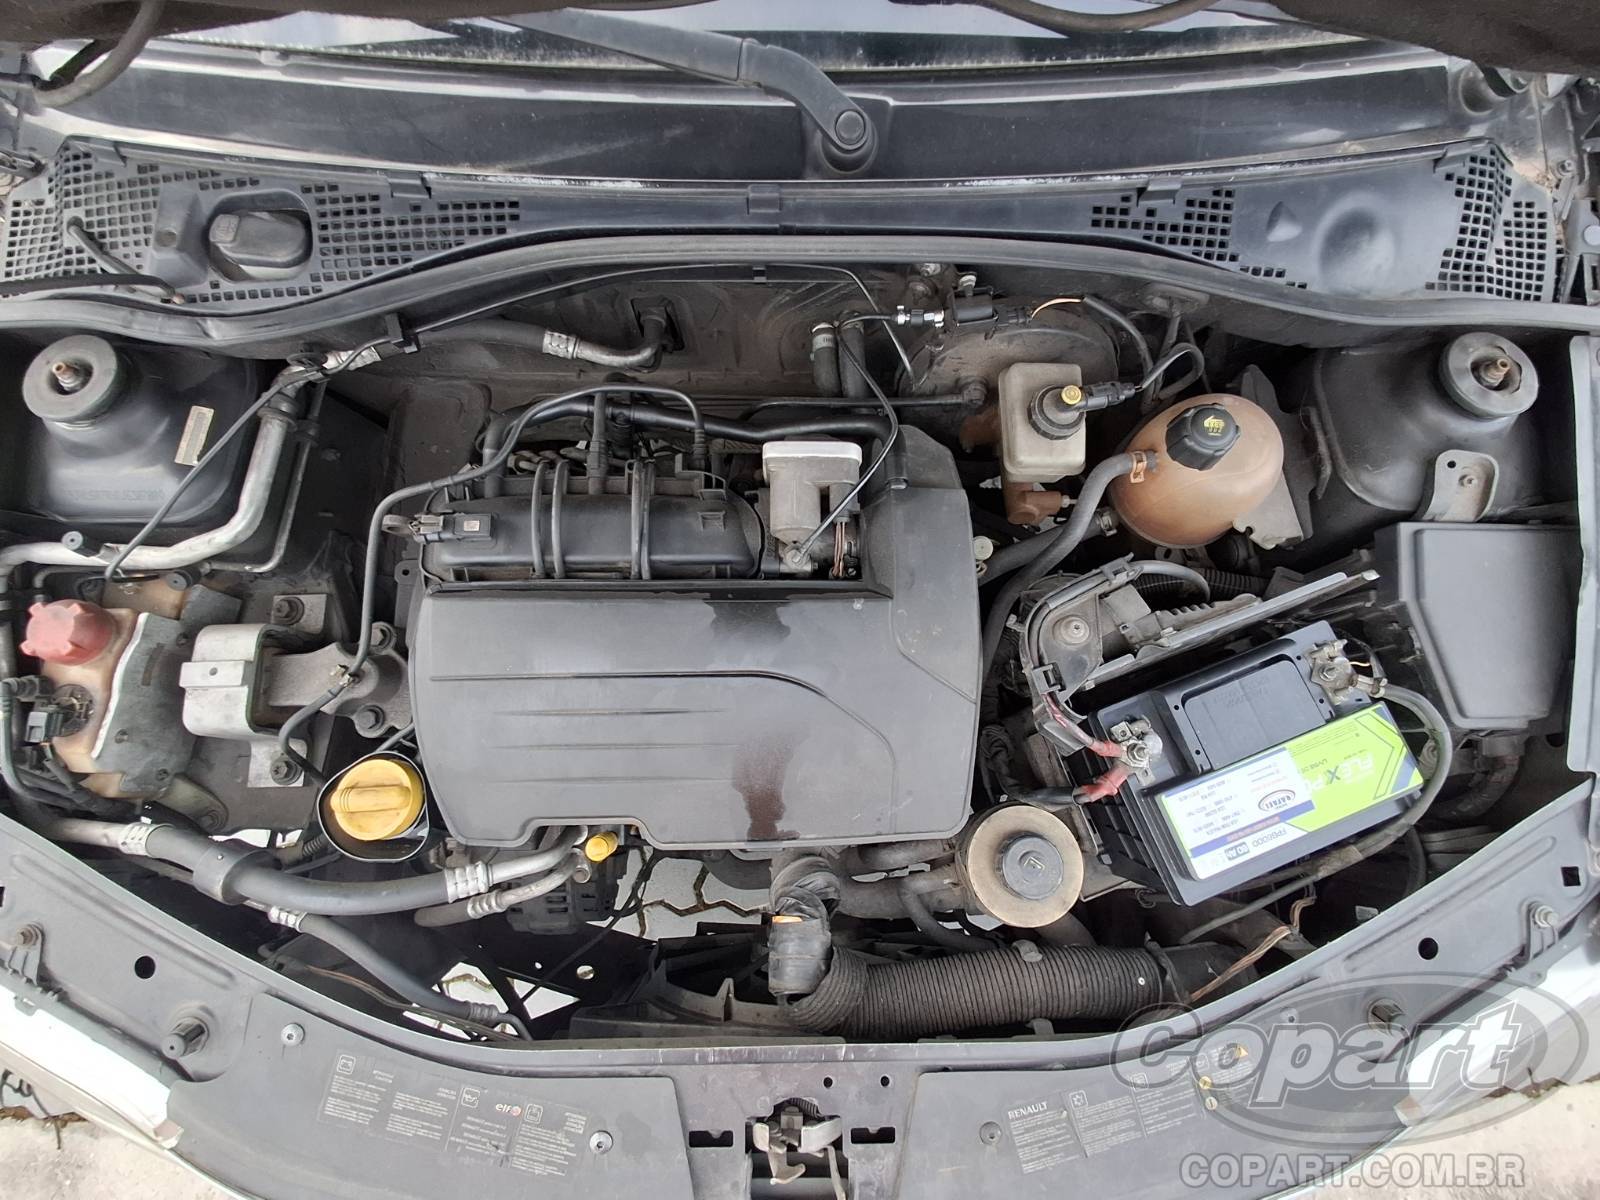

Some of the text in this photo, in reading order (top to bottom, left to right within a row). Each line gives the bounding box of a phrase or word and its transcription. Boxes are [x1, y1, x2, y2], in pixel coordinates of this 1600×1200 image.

[1265, 795, 1292, 809] RAFAEL
[495, 1103, 512, 1113] elf
[1008, 1101, 1048, 1120] RENAULT
